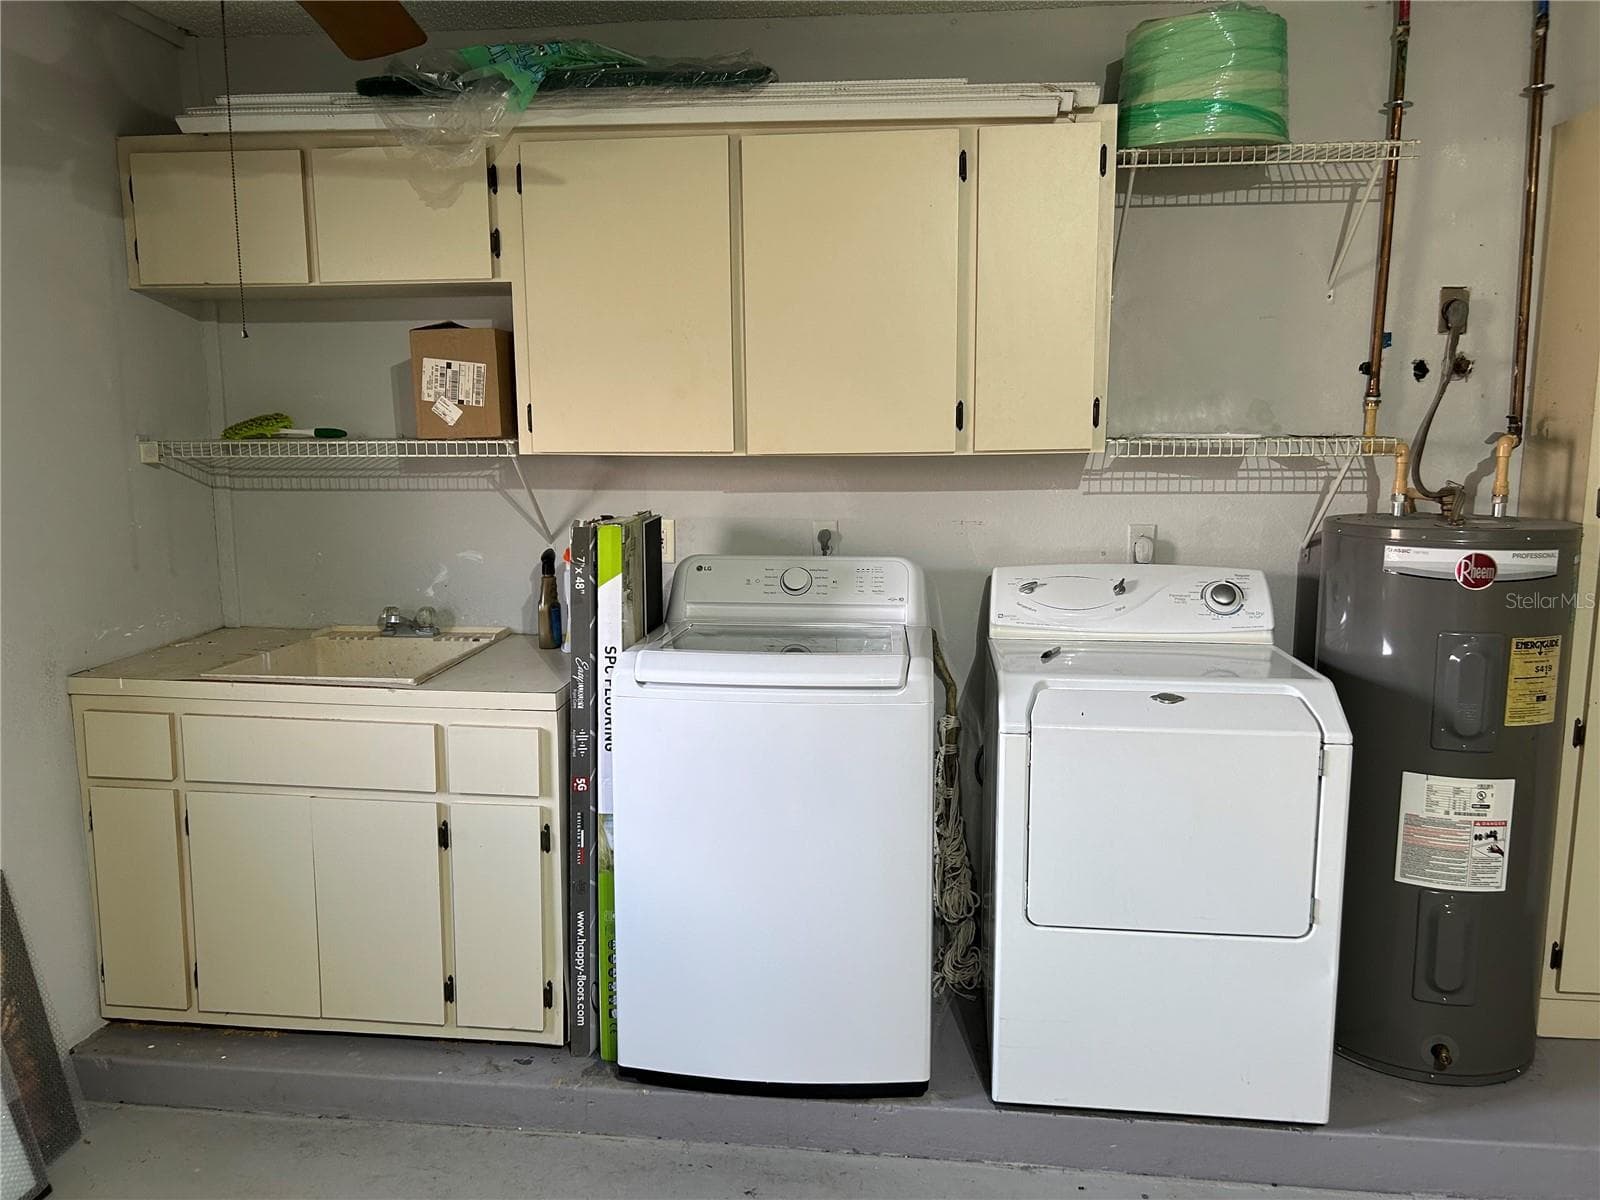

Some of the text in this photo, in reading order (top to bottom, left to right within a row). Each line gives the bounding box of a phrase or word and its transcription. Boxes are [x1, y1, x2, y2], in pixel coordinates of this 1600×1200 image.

[1459, 553, 1495, 584] Rheem
[575, 778, 587, 791] 5G
[575, 910, 587, 1027] www.happy-floors.com
